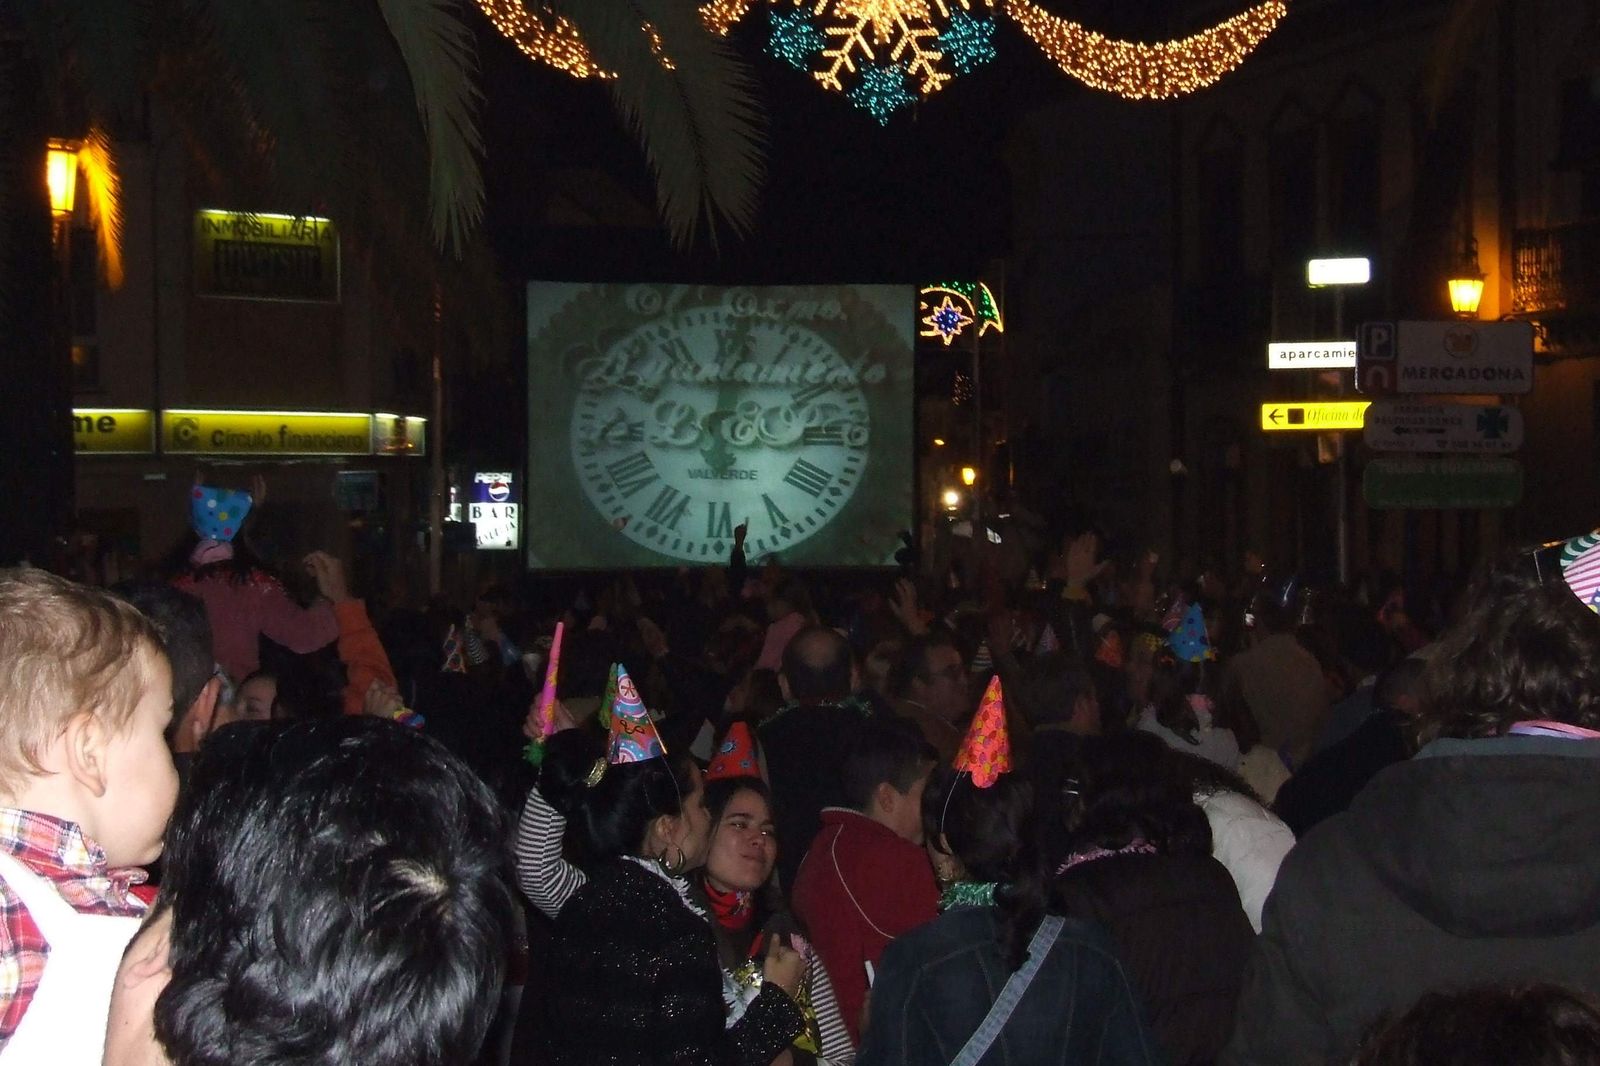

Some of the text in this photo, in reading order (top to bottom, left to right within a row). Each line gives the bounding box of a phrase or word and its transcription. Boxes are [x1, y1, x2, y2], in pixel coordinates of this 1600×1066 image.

[1371, 328, 1388, 354] P
[1280, 347, 1356, 362] aparcamie
[1401, 366, 1526, 381] MERCADONA
[1306, 408, 1349, 425] Oficina
[687, 469, 758, 481] VALVERDE
[472, 506, 515, 520] BAR
